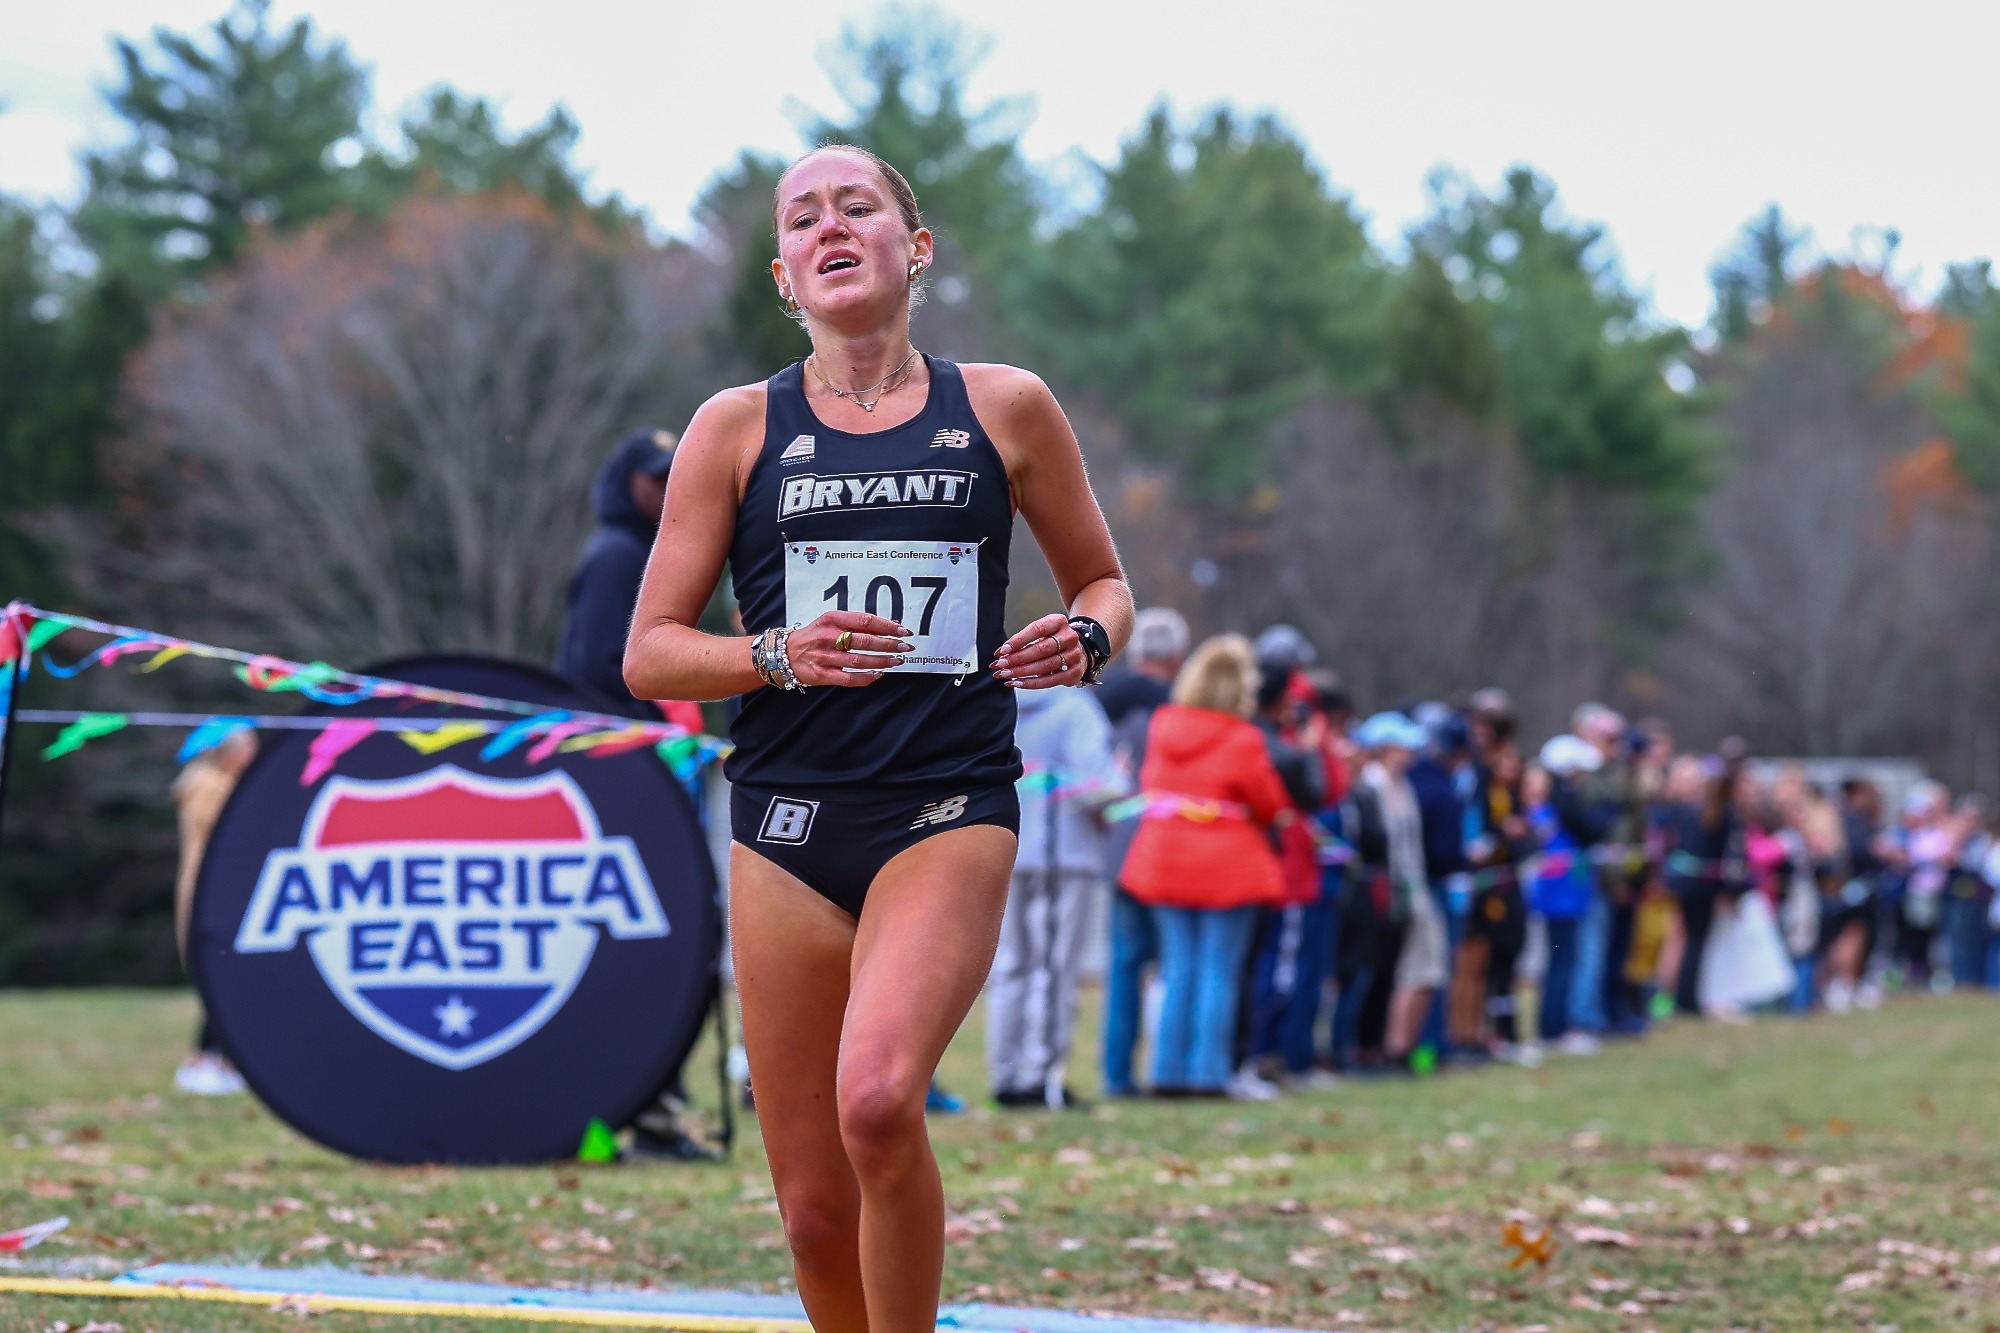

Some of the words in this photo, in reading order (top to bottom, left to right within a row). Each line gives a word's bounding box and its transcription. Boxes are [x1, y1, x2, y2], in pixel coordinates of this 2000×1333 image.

[929, 428, 970, 449] NB
[782, 474, 966, 516] BRYANT
[824, 550, 864, 560] America
[866, 550, 889, 560] East
[890, 550, 944, 560] Conference
[823, 575, 948, 636] 107
[764, 802, 810, 840] B
[262, 853, 643, 936] AMERICA
[347, 919, 559, 973] EAST
